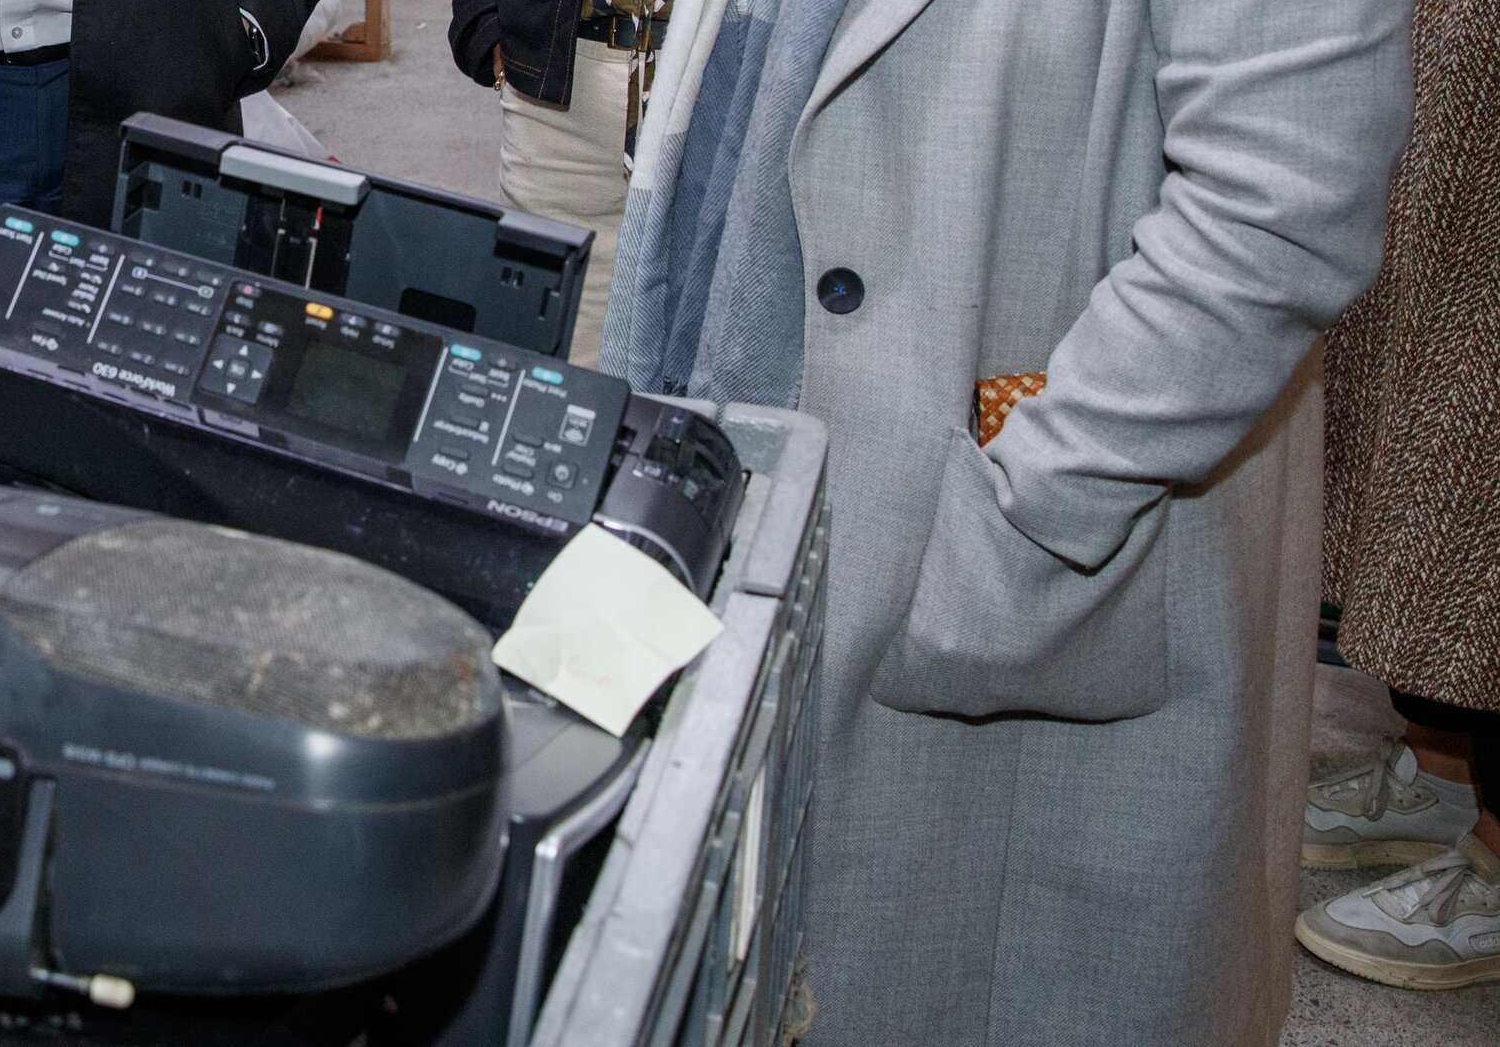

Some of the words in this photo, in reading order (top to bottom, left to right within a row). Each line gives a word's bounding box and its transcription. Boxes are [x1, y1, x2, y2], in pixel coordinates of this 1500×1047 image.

[91, 360, 118, 380] 630
[116, 368, 176, 397] WorkForce
[486, 498, 569, 532] EPSON
